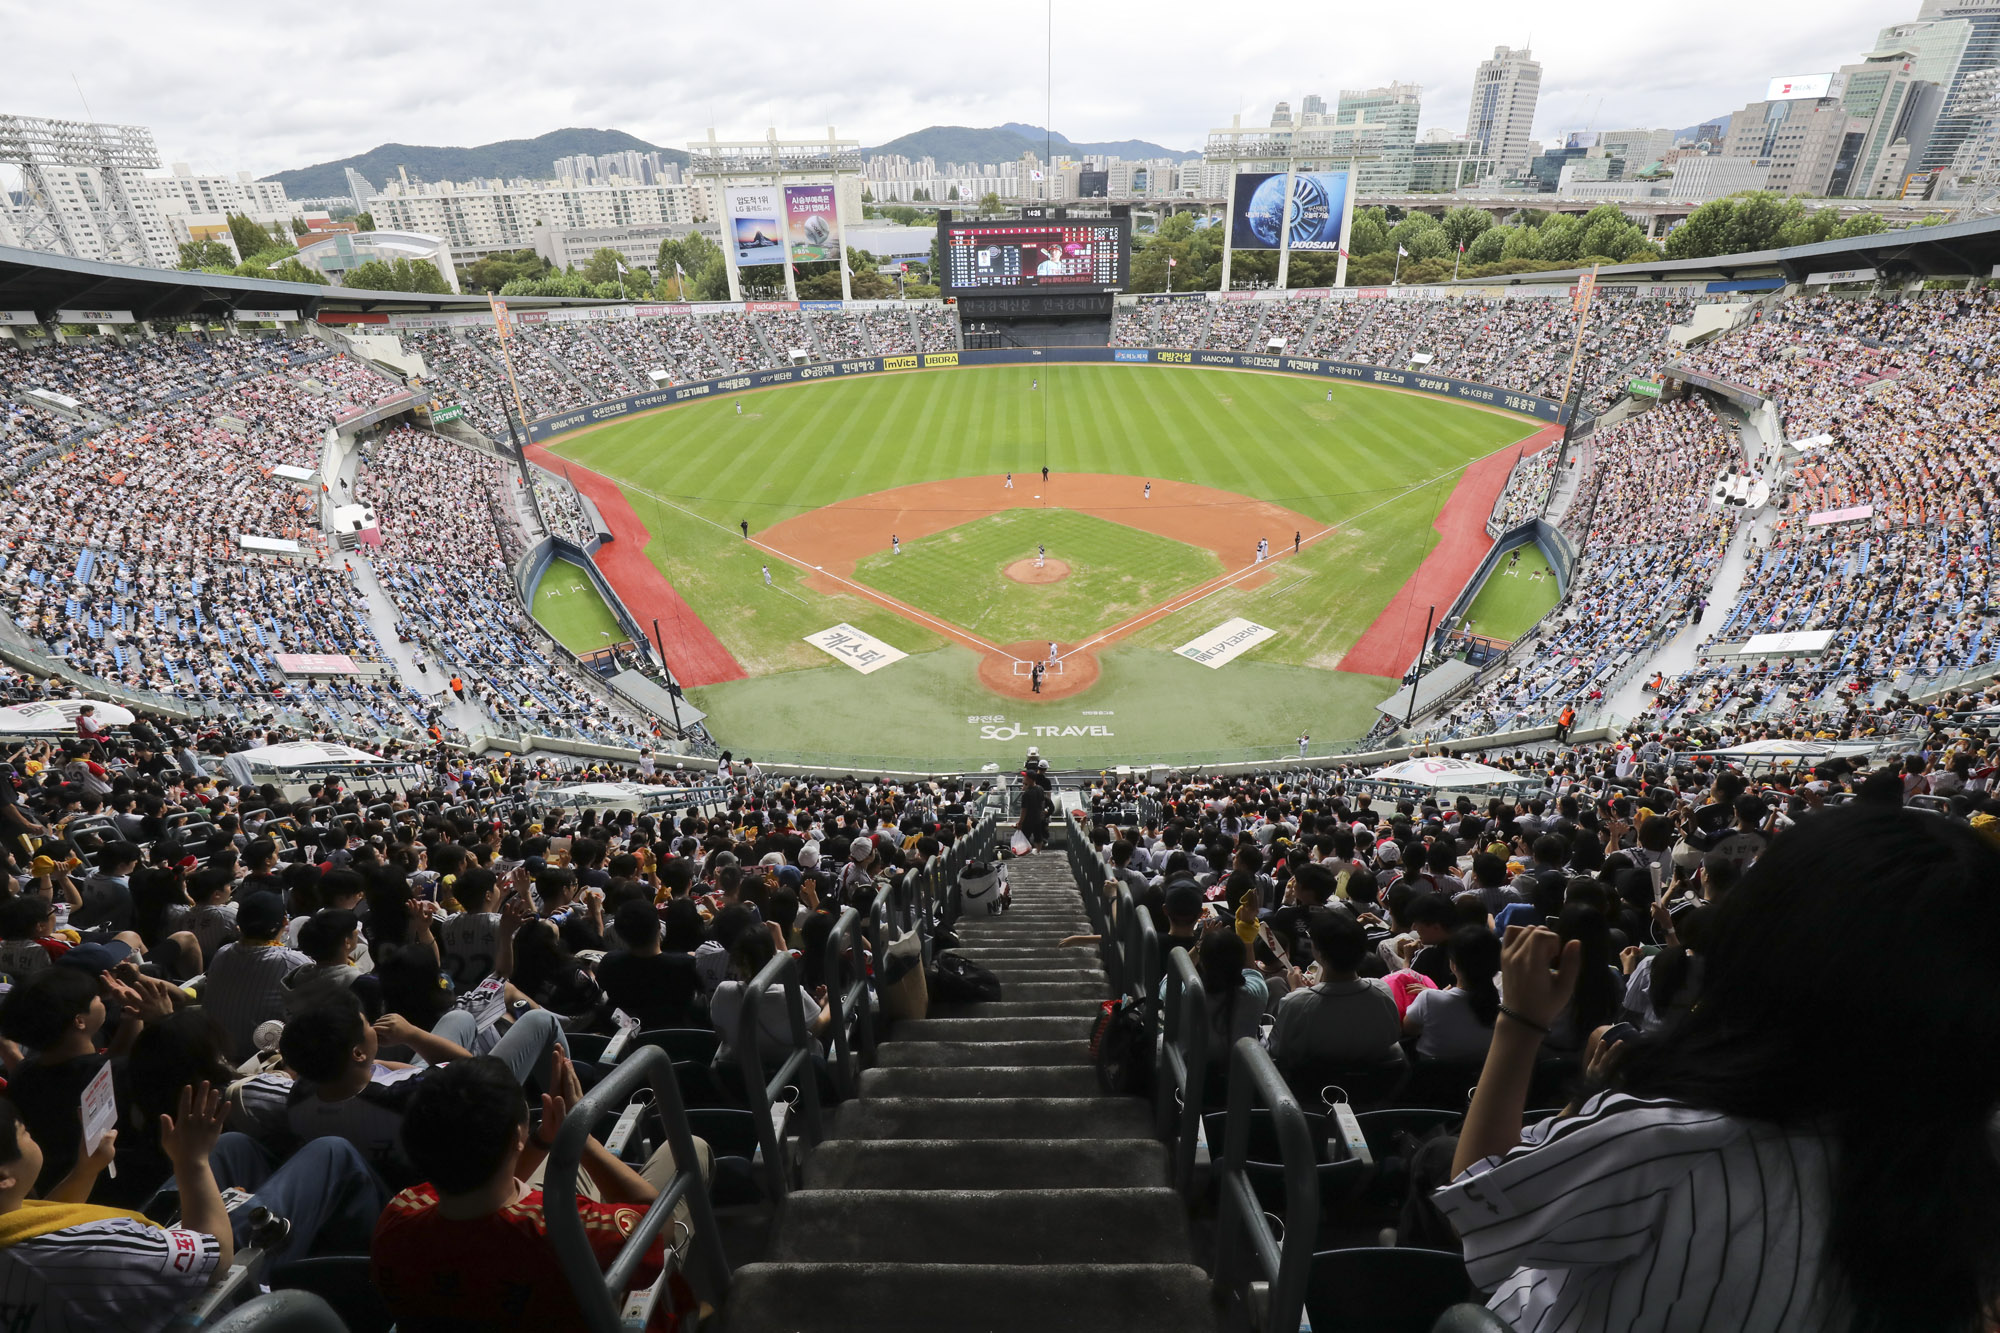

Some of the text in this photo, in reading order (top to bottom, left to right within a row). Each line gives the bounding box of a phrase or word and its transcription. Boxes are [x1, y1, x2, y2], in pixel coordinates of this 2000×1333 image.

[737, 195, 769, 205] 압도적 1위
[1290, 241, 1337, 249] DOOSAN
[753, 302, 778, 310] redcap
[964, 299, 1033, 313] 한국경제신문
[1042, 298, 1107, 312] 한국경제TV
[925, 354, 958, 365] UBORA
[1157, 351, 1192, 363] 대방건설
[1201, 355, 1234, 364] HANCOM
[1254, 356, 1280, 368] 대보건설
[811, 364, 835, 377] 금강주택
[842, 361, 876, 373] 현대해상
[1287, 359, 1320, 372] 치킨마루
[1328, 365, 1363, 377] 한국경제TV
[634, 393, 668, 408] 한국경제신문
[1504, 395, 1536, 413] 키움증권
[599, 401, 627, 416] 유안타증권
[550, 414, 586, 431] BNK캐피탈
[823, 632, 887, 667] 캐스퍼
[1194, 624, 1264, 662] 메디카코리아
[968, 714, 1005, 724] 환전은
[980, 722, 1115, 741] SOL TRAVEL
[446, 930, 496, 946] 김현수
